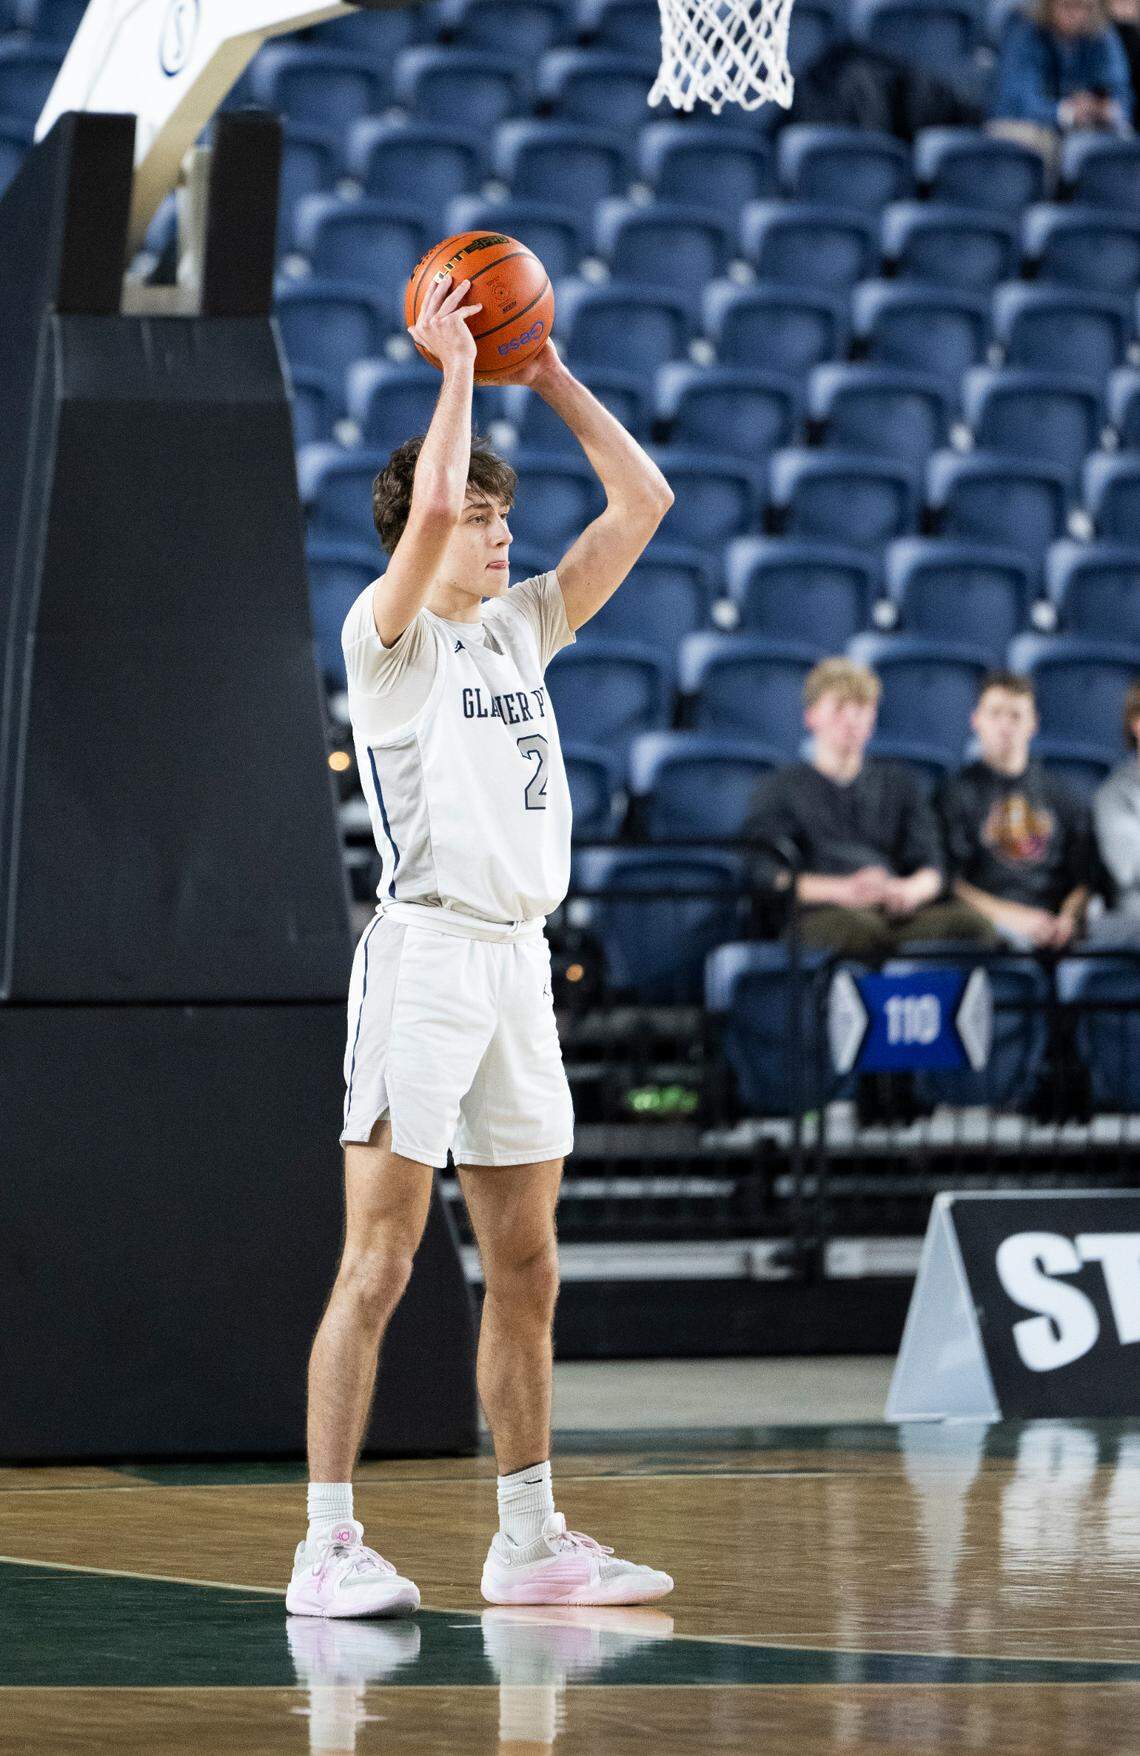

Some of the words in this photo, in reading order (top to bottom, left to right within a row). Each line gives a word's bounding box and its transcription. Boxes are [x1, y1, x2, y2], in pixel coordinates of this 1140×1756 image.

[462, 688, 534, 725] GLAIER
[530, 687, 545, 717] P
[517, 733, 548, 810] 2
[996, 1231, 1140, 1372] ST
